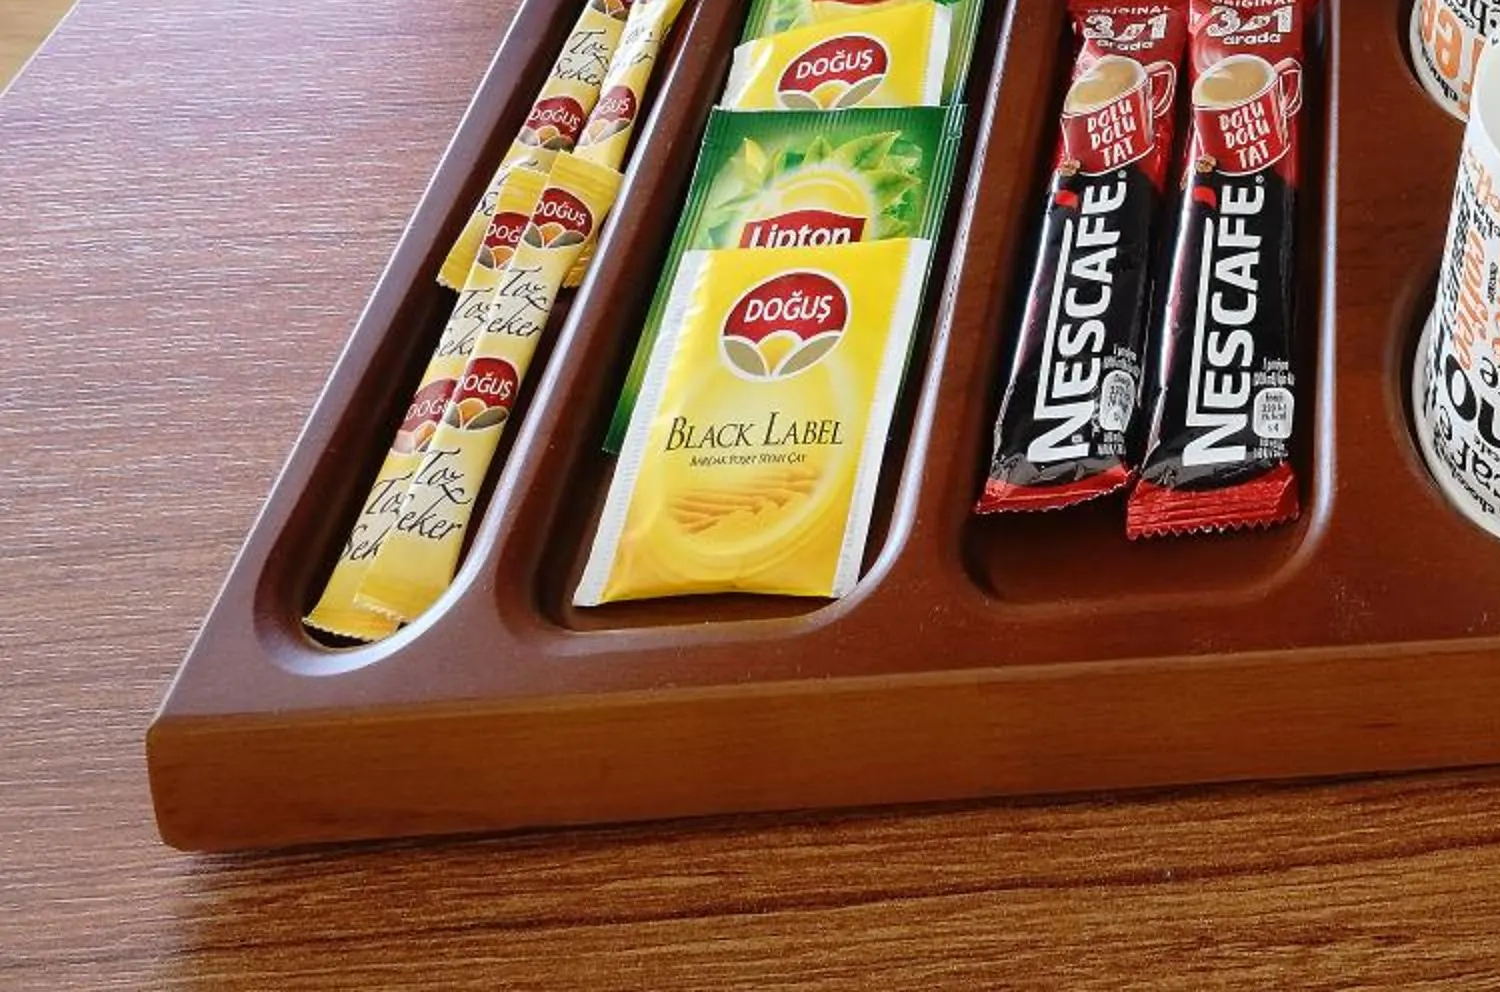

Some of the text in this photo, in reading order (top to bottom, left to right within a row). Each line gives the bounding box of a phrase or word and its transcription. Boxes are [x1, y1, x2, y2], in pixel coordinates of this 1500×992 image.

[796, 49, 874, 80] DOĞUŞ
[1087, 99, 1134, 134] DOLU
[1218, 99, 1266, 133] DOLU
[1090, 117, 1137, 151] DOLU
[1223, 118, 1271, 150] DOLU
[1100, 139, 1135, 168] TAT
[1235, 140, 1270, 169] TAT
[750, 223, 852, 249] Lipton
[743, 289, 833, 325] DOĞUŞ
[664, 411, 844, 452] BLACK LABEL
